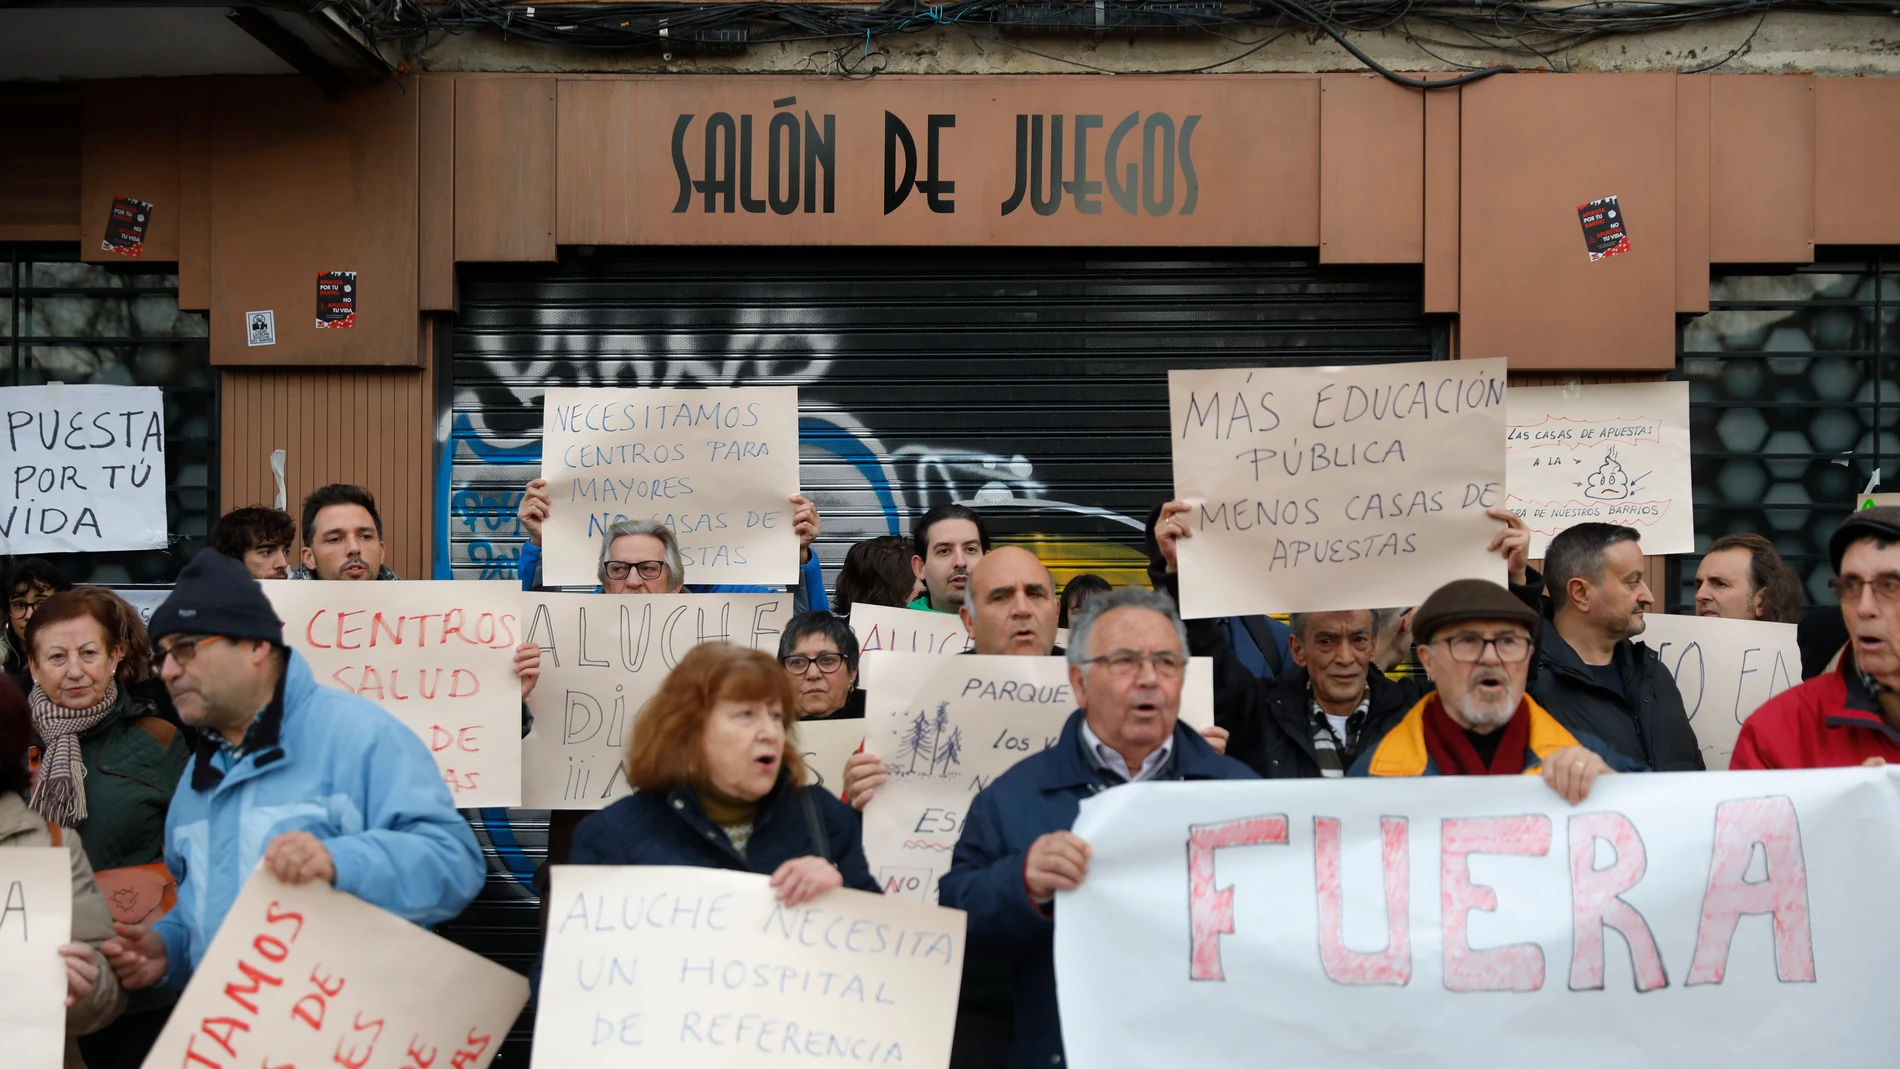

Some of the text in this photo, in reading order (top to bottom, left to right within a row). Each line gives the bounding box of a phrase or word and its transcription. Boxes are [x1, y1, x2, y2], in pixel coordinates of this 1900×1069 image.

[671, 96, 1203, 217] SALÓN DE JUEGOS
[1583, 215, 1595, 223] POR
[1610, 232, 1624, 240] VIDA
[551, 402, 762, 433] NECESITAMOS
[1182, 371, 1506, 439] MÁS EDUCACIÓN
[7, 409, 163, 452] PUESTA
[1508, 425, 1653, 441] LAS CASAS DE APUESTAS
[564, 440, 770, 468] CENTROS PARA
[1236, 438, 1407, 482] PÚBLICA
[1533, 456, 1561, 467] A LA
[14, 457, 152, 500] POR TÚ
[571, 477, 694, 504] MAYORES
[651, 512, 728, 536] ASAS
[746, 510, 782, 529] DE
[1199, 483, 1502, 532] MENOS CASAS DE
[1534, 508, 1547, 517] DE
[1551, 508, 1601, 518] NUESTROS
[1608, 504, 1659, 515] BARRIOS
[679, 545, 748, 567] STAS
[1269, 532, 1417, 572] APUESTAS
[305, 607, 516, 650] CENTROS
[332, 665, 482, 700] SALUD
[961, 677, 1070, 704] PARQUE
[429, 724, 485, 753] DE
[884, 876, 920, 895] NO
[1186, 794, 1818, 993] FUERA
[559, 891, 954, 965] ALUCHE NECESITA
[290, 961, 346, 1032] DE
[577, 956, 897, 1005] UN HOSPITAL
[590, 1010, 905, 1064] DE REFERENCIA
